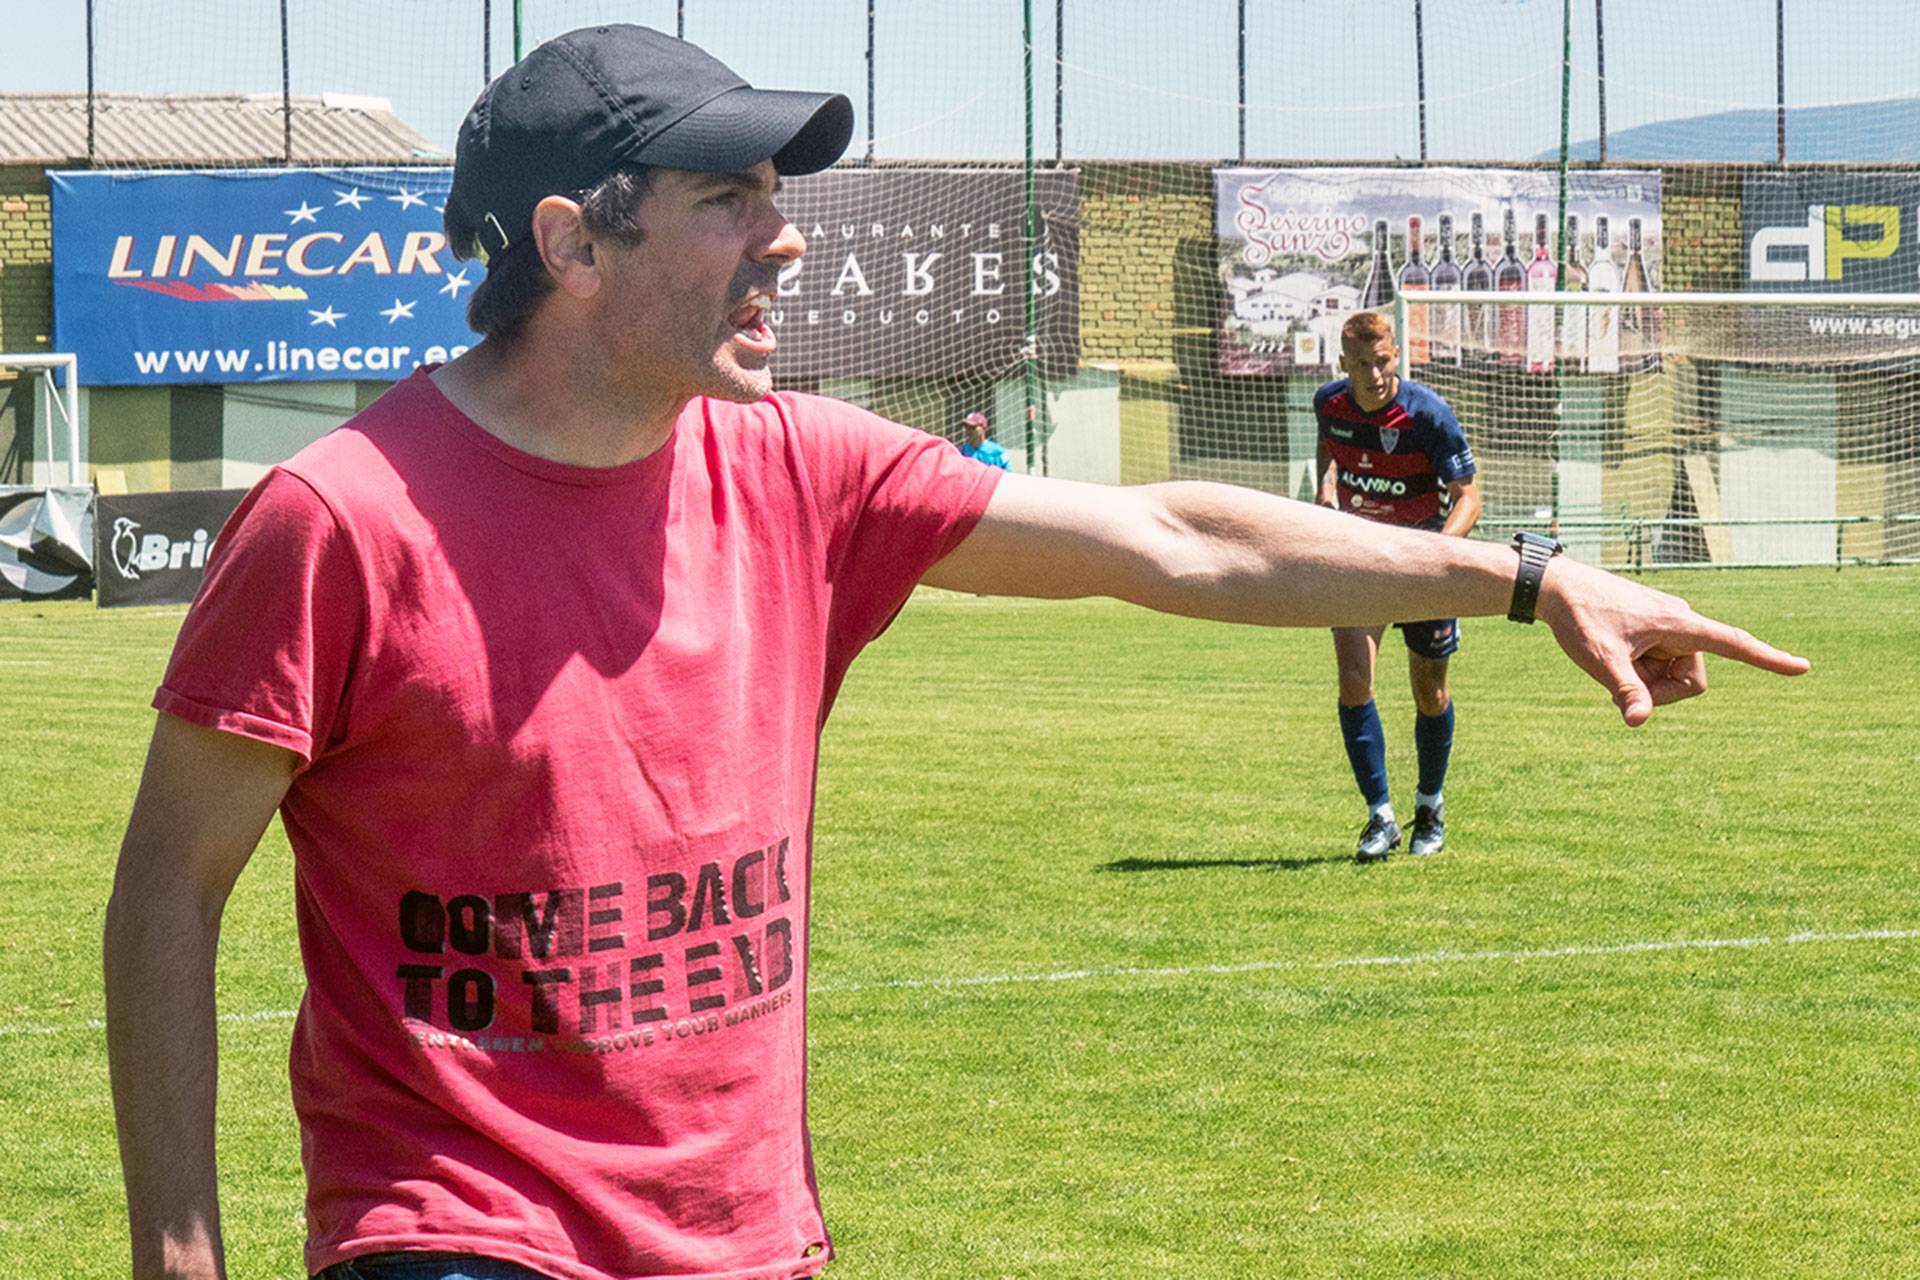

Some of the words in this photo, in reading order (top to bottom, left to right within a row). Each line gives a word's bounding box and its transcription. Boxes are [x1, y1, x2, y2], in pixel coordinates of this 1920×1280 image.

[811, 223, 1001, 239] AURANTE
[1237, 184, 1366, 233] Severino
[108, 231, 448, 279] LINECAR
[777, 252, 1061, 297] SARES
[762, 309, 1001, 325] UEDUCTO
[399, 882, 624, 960] COME
[647, 837, 790, 941] BACK
[397, 963, 497, 1032] TO
[522, 952, 668, 1035] THE
[661, 1014, 720, 1041] YOUR
